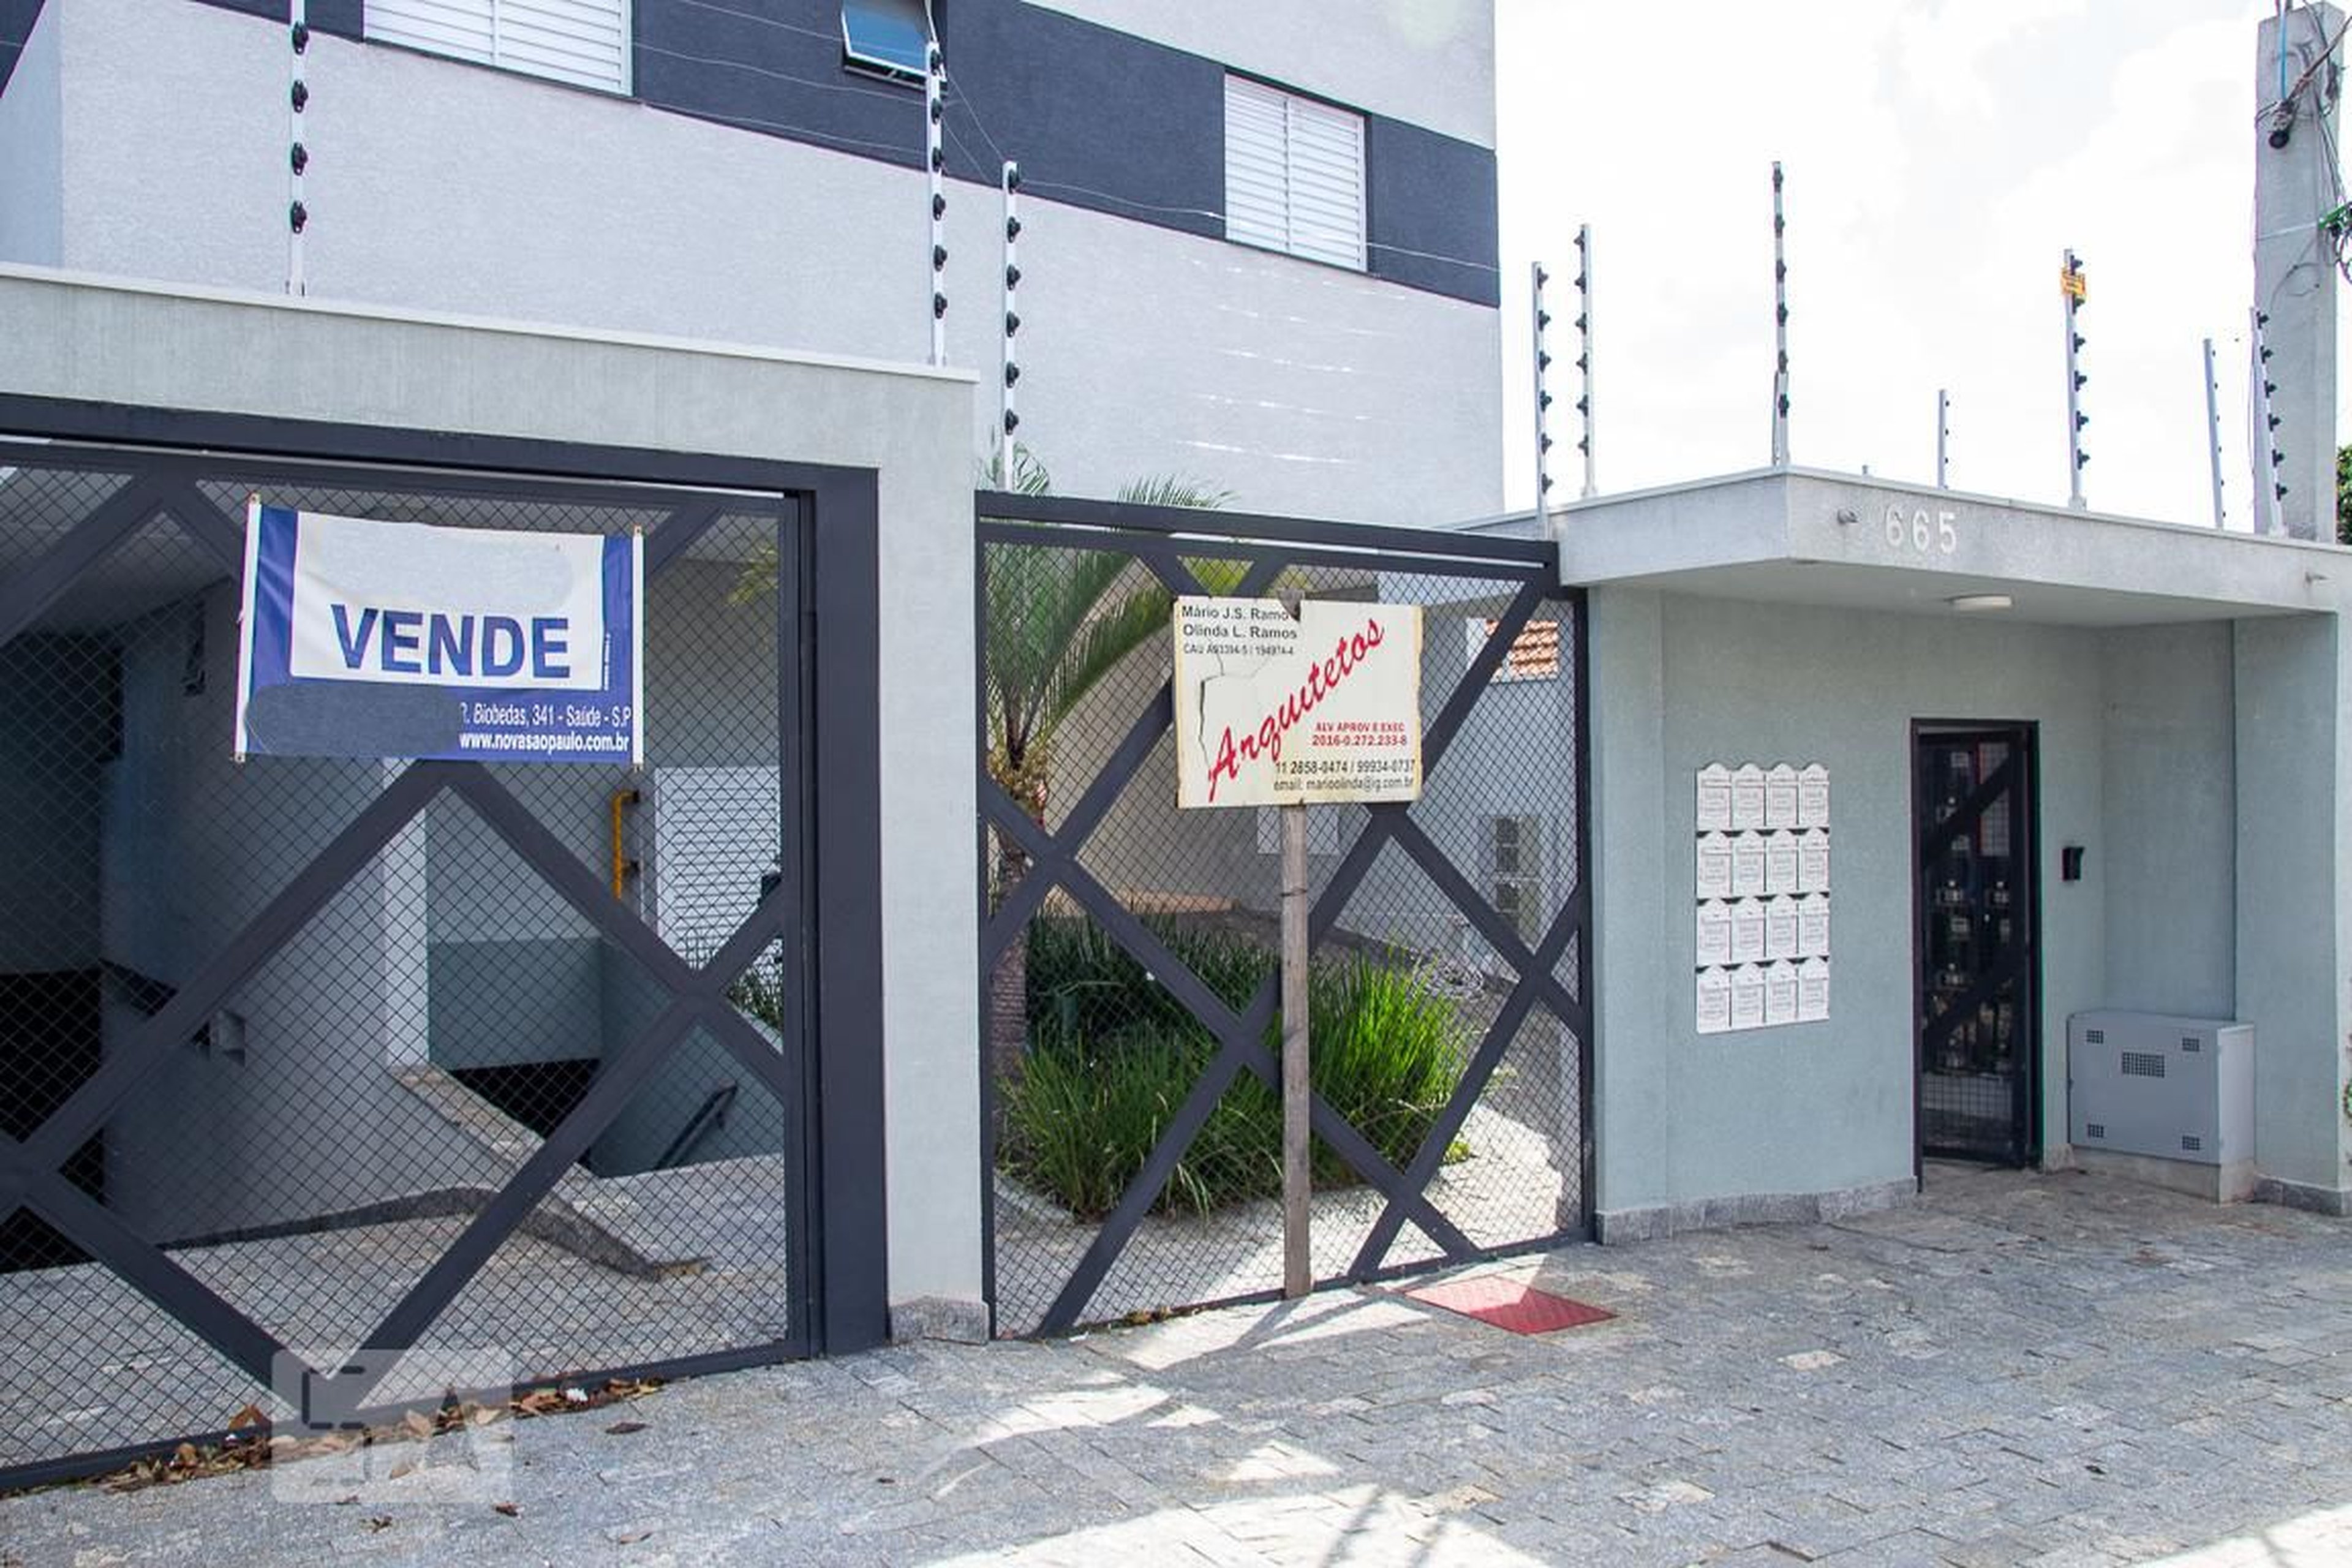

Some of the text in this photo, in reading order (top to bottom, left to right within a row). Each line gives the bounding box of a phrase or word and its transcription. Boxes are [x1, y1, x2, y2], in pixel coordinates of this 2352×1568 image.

[1884, 503, 1957, 554] 665
[1182, 605, 1289, 620] Mário J.S. Ramo
[330, 603, 570, 679] VENDE
[1183, 624, 1297, 639] Olinda L. Ramos
[532, 704, 554, 726] 341
[566, 705, 601, 728] Saúde
[1208, 618, 1385, 802] Arquitetos
[1315, 722, 1406, 732] ALV APROV E EXEC
[459, 731, 630, 755] www.novasaopaulo.com.br
[1273, 777, 1303, 791] email:
